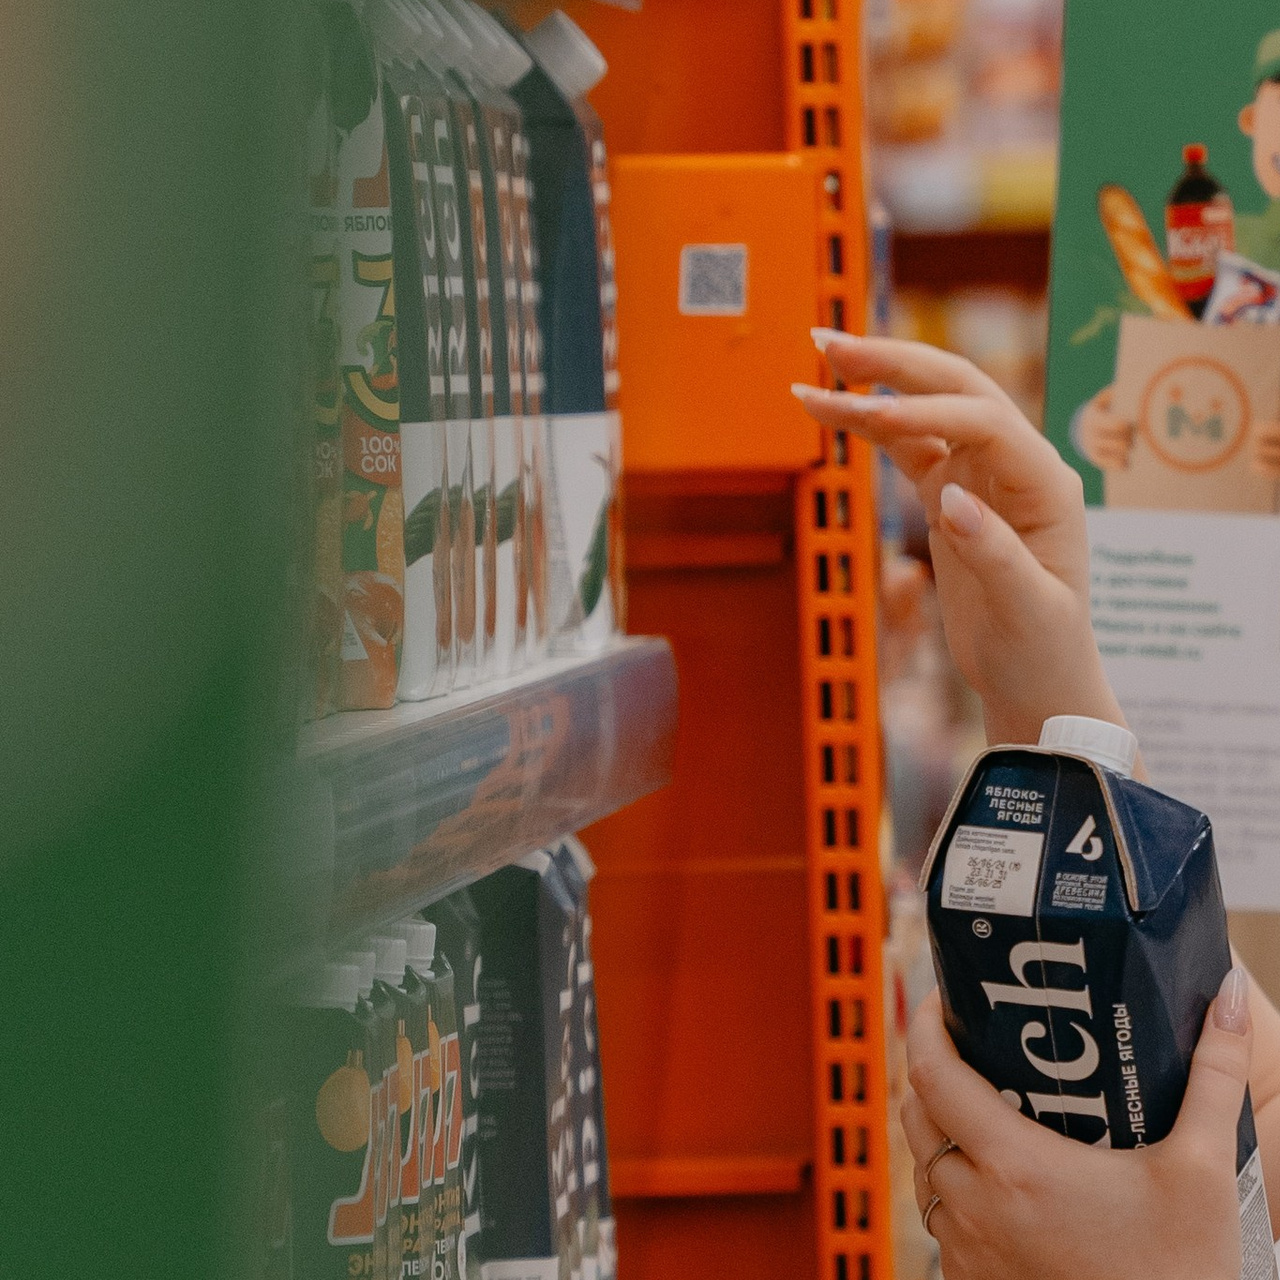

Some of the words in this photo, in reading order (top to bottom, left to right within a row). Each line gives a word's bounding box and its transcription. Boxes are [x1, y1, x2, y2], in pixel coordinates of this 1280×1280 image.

[361, 455, 397, 474] СОК
[985, 786, 1045, 800] ЯБЛОКО-
[989, 798, 1045, 813] ЛЕСНЫЕ
[996, 811, 1043, 825] ЯГОДЫ
[1112, 1002, 1135, 1061] ЯГОДЫ
[979, 936, 1111, 1149] ich
